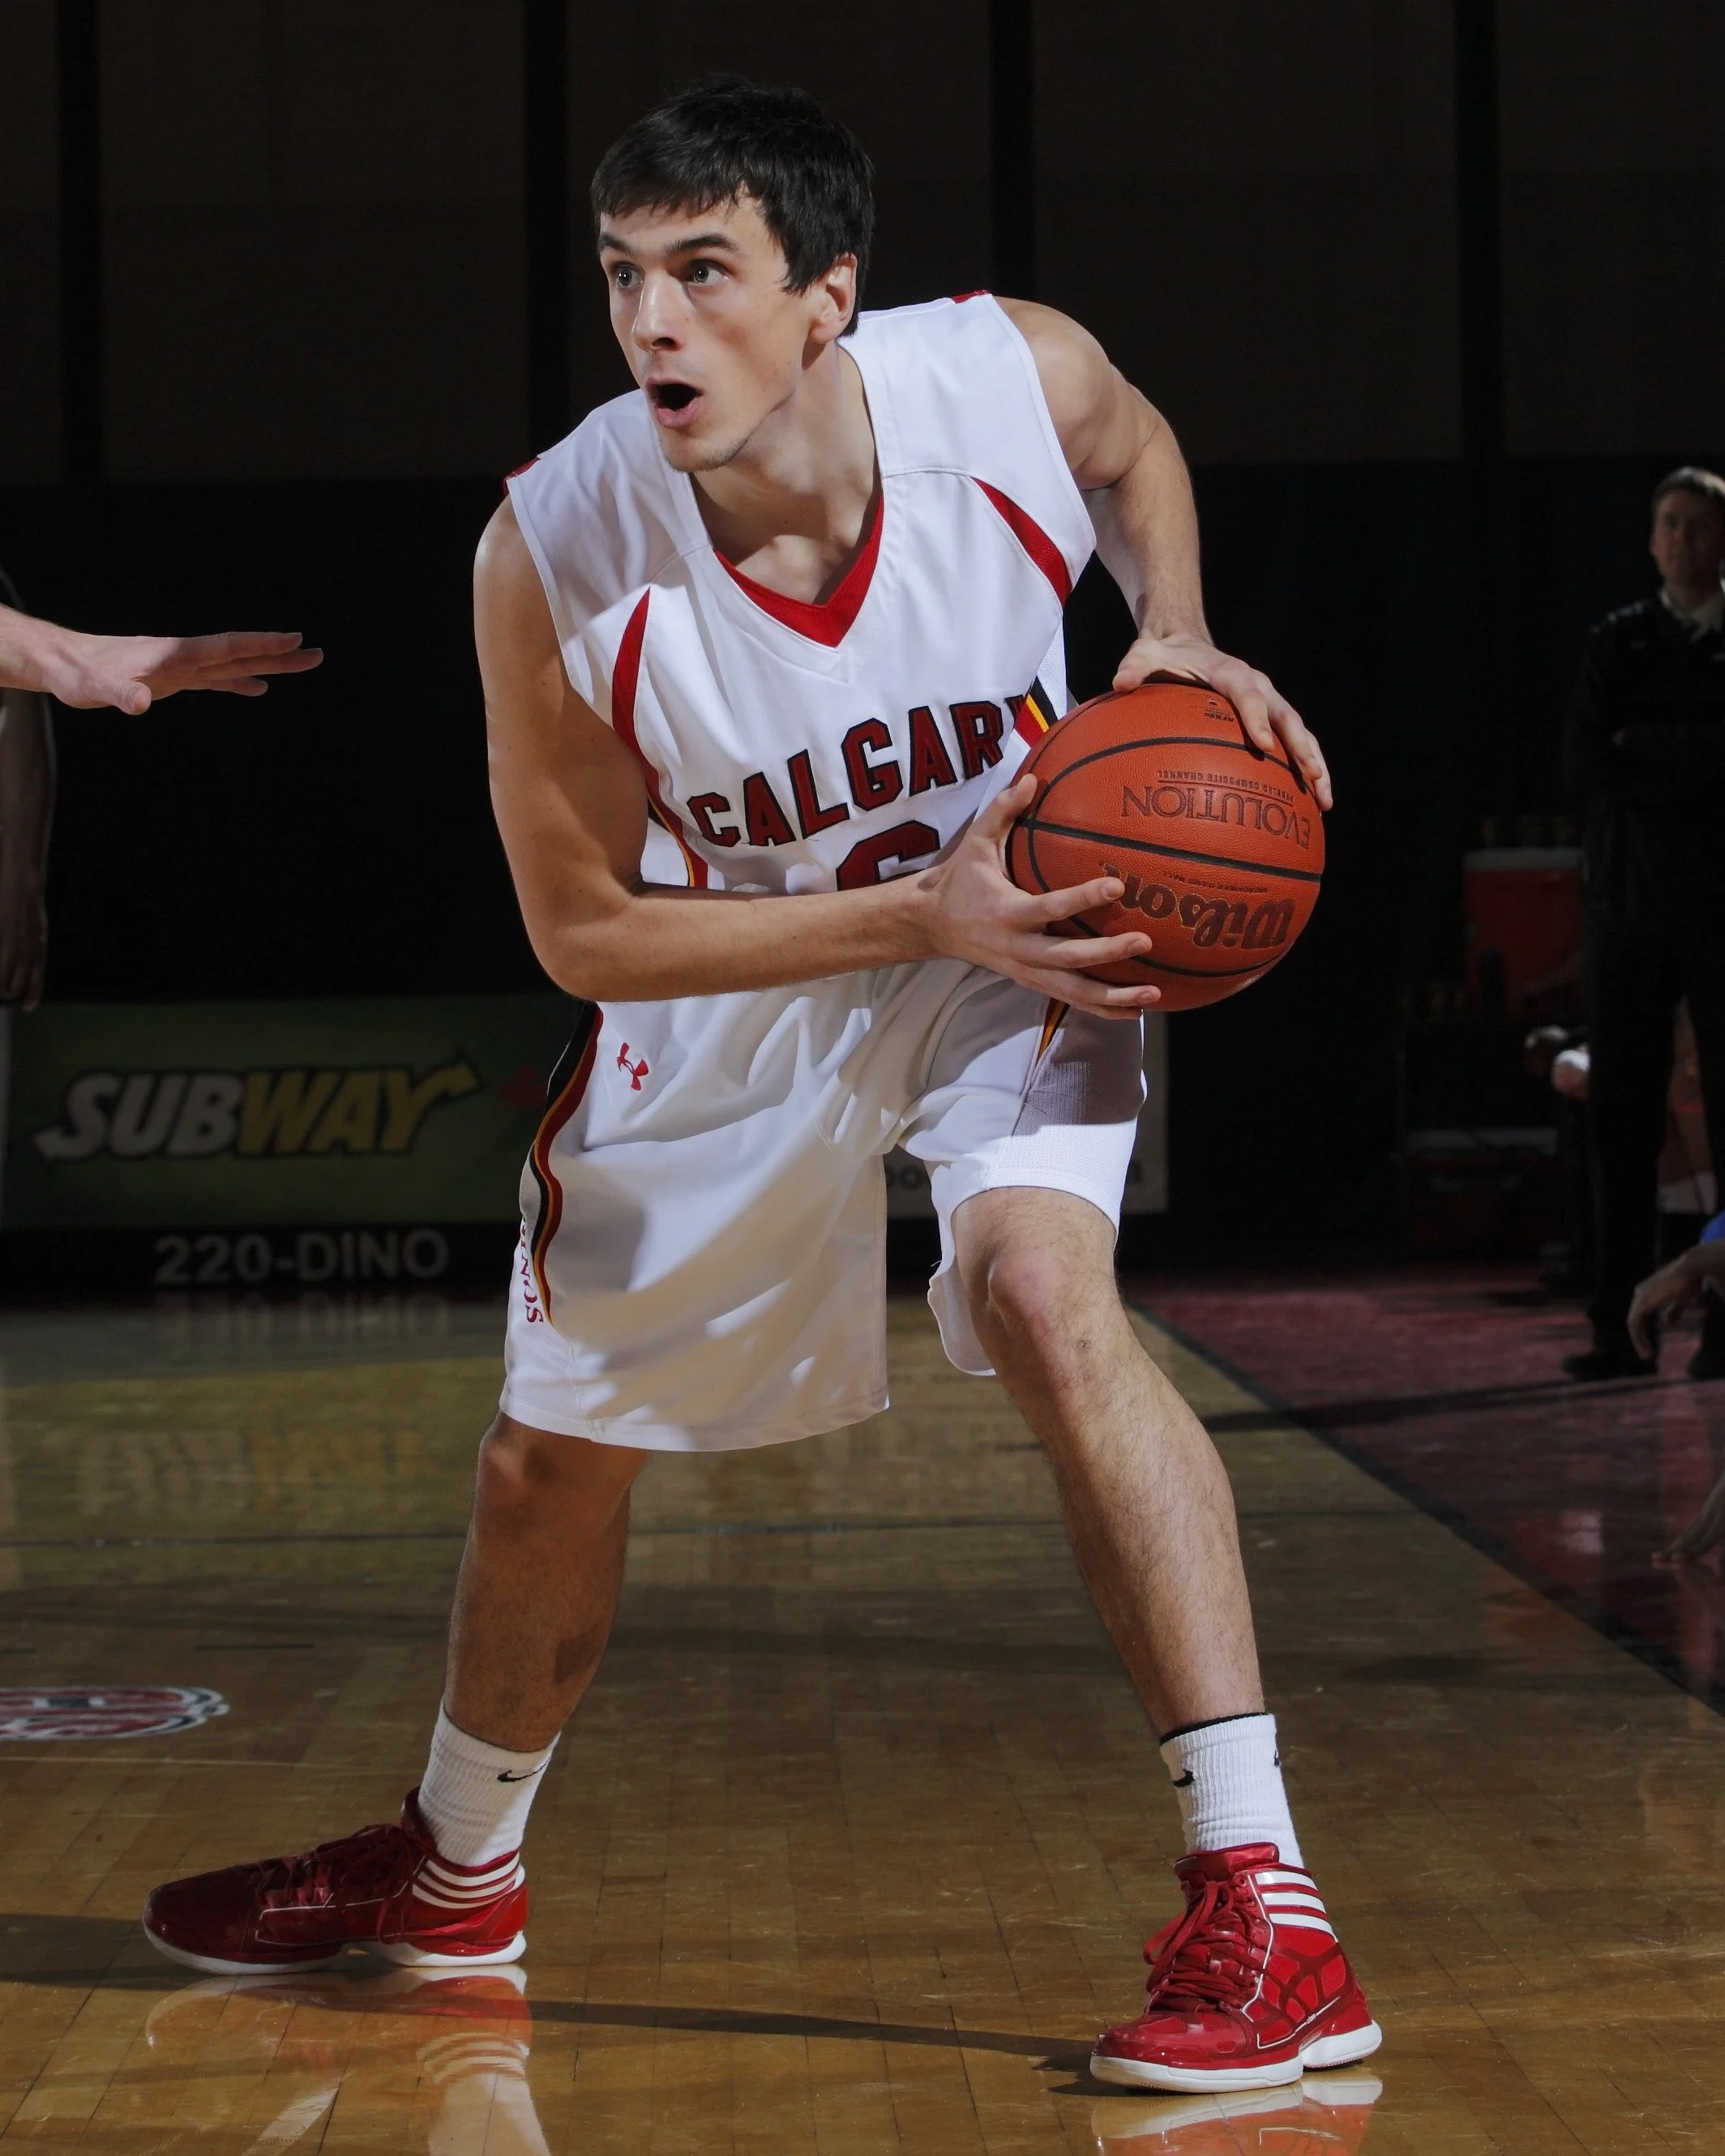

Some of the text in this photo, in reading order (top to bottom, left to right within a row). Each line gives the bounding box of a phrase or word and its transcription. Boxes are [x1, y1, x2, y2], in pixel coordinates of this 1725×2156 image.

[1158, 770, 1204, 781] CHANNEL
[1120, 785, 1312, 850] EVOLUTION
[1103, 862, 1295, 951] Wilson
[33, 1049, 482, 1162] SUBWAY
[154, 1226, 450, 1285] 220-DINO
